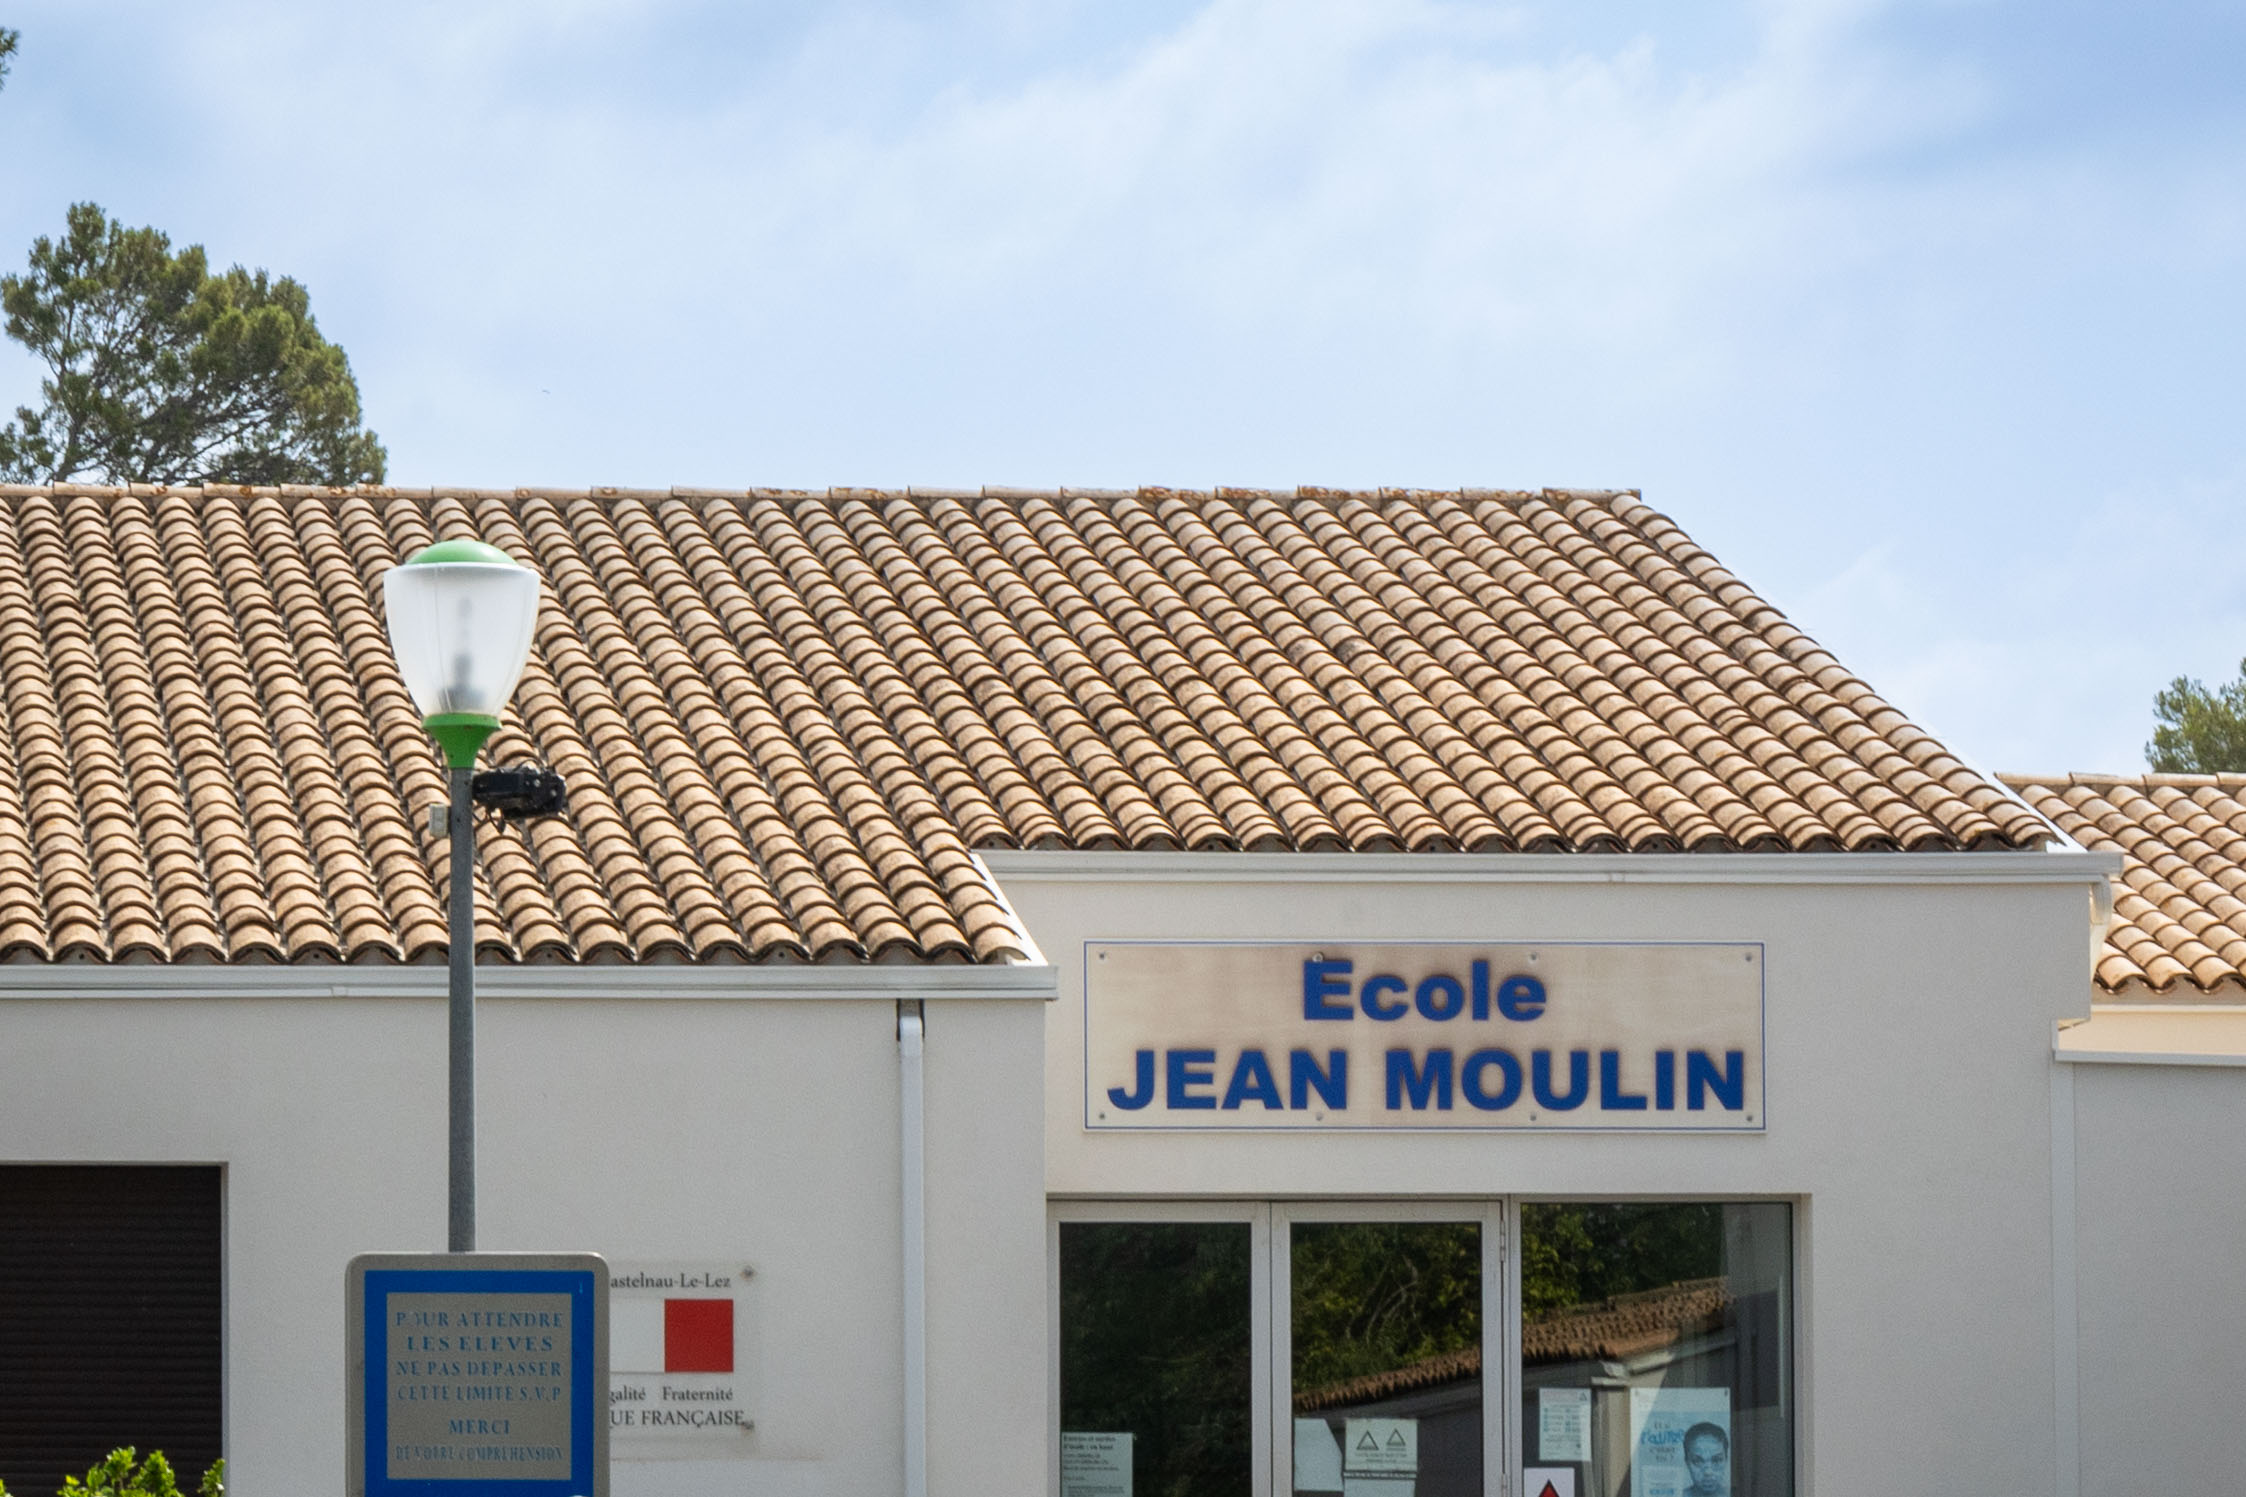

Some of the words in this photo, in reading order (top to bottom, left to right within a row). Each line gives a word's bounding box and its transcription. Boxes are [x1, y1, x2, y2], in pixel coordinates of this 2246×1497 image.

[1303, 959, 1547, 1021] Ecole
[1107, 1050, 1347, 1111] JEAN
[1385, 1050, 1744, 1111] MOULIN
[611, 1271, 732, 1288] astelnau-Le-Lez
[457, 1312, 563, 1328] ATTENDRE
[407, 1336, 450, 1351] LES
[459, 1336, 553, 1351] ELEVES
[396, 1361, 420, 1376] NE
[428, 1361, 461, 1376] PAS
[467, 1361, 561, 1376] DEPASSER
[397, 1385, 449, 1400] CETTE
[456, 1385, 513, 1400] LIMITE
[610, 1385, 646, 1404] galité
[662, 1386, 733, 1402] Fraternité
[449, 1420, 510, 1434] MERCI
[642, 1410, 744, 1428] FRANÇAISE
